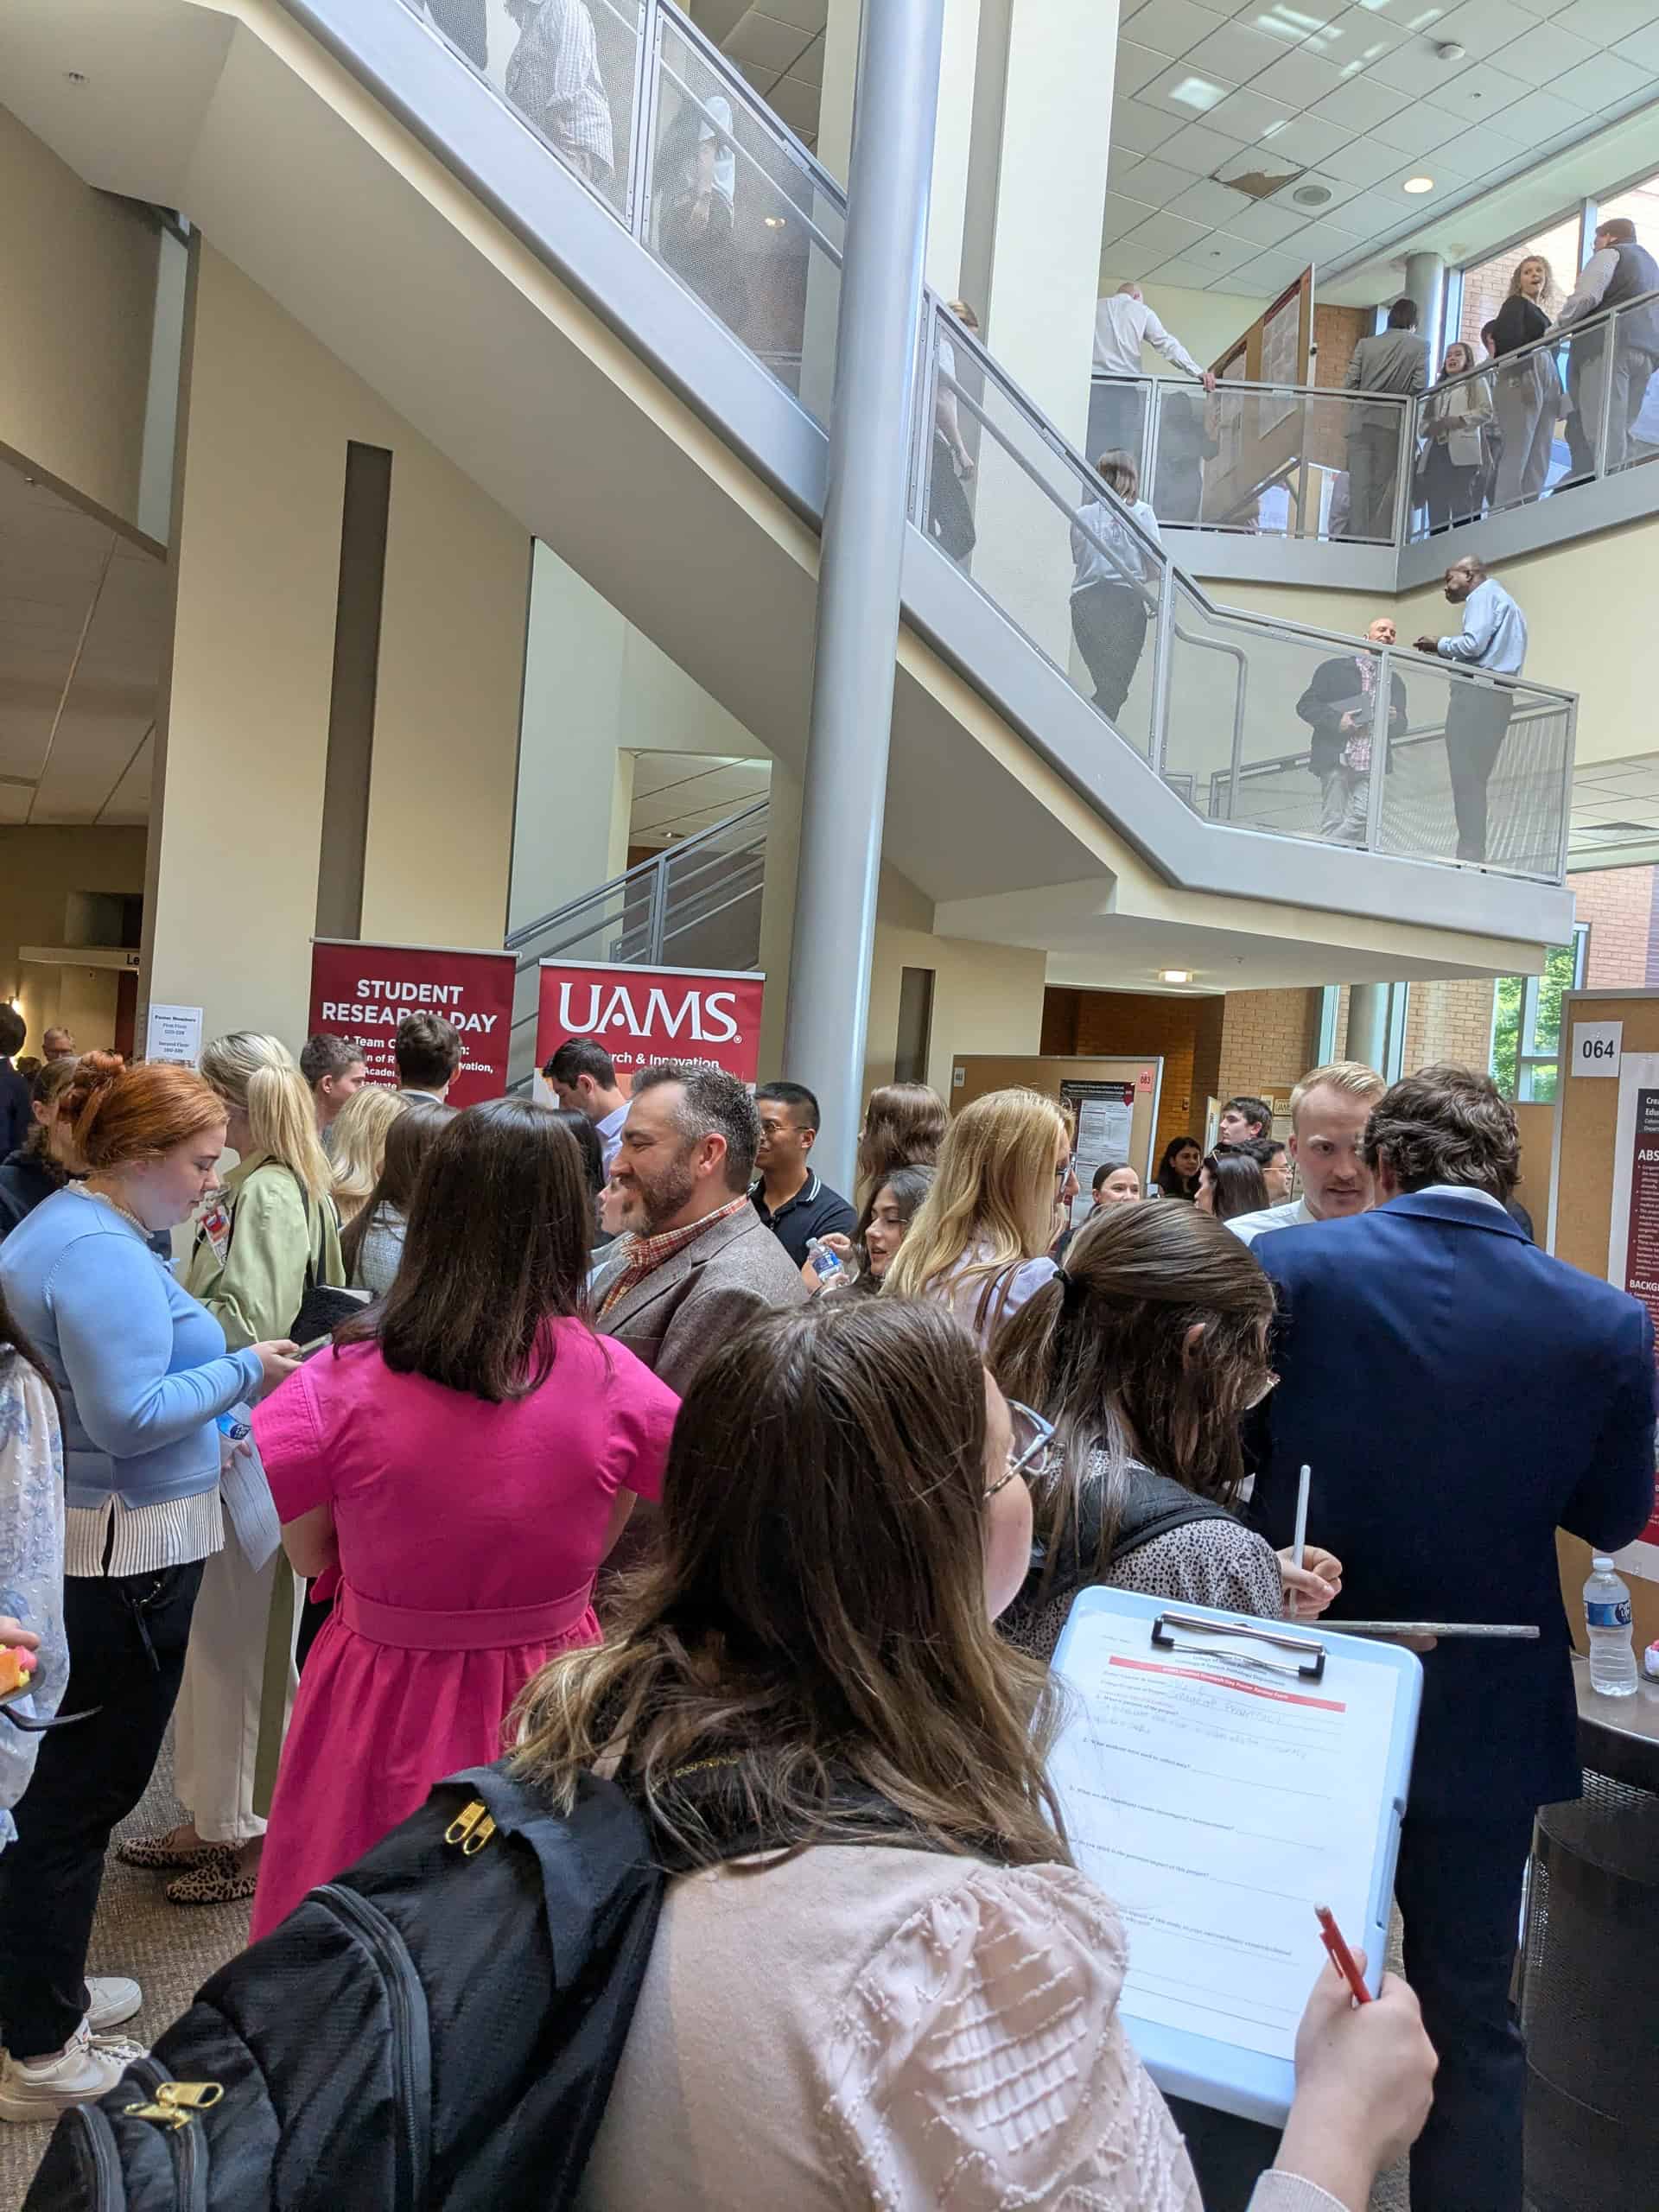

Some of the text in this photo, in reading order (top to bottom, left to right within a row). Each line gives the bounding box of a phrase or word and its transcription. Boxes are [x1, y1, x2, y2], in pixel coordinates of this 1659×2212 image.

[356, 979, 464, 1004] STUDENT
[322, 1001, 498, 1033] RESEAR DAY
[353, 1036, 385, 1049] Team
[1582, 1039, 1615, 1059] 064
[375, 1053, 386, 1063] of
[635, 1053, 646, 1065] &
[1630, 1279, 1659, 1293] BACKG
